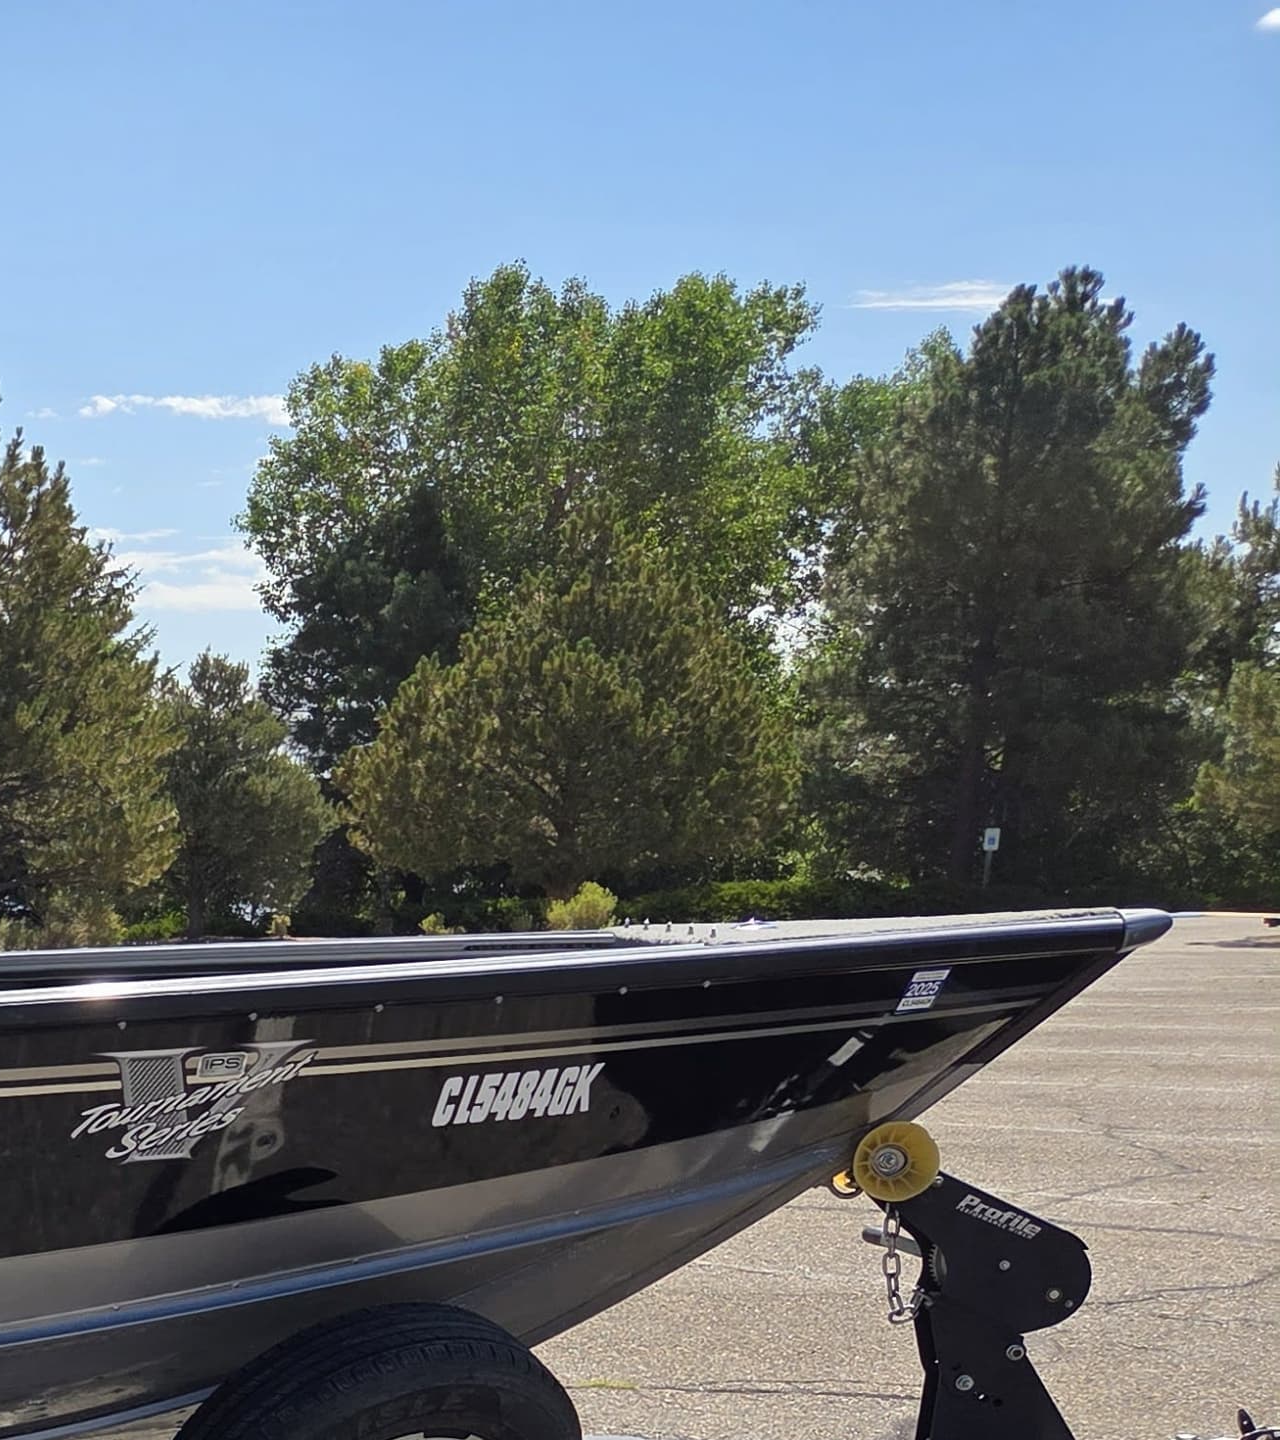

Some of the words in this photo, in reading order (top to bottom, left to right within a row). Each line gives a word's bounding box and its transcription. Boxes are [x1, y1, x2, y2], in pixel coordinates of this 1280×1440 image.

[905, 981, 941, 997] 2025
[204, 1057, 241, 1070] IPS
[70, 1051, 318, 1139] Tournament
[431, 1062, 606, 1128] CL5484GK
[104, 1106, 245, 1159] Series
[955, 1193, 1042, 1237] Profile
